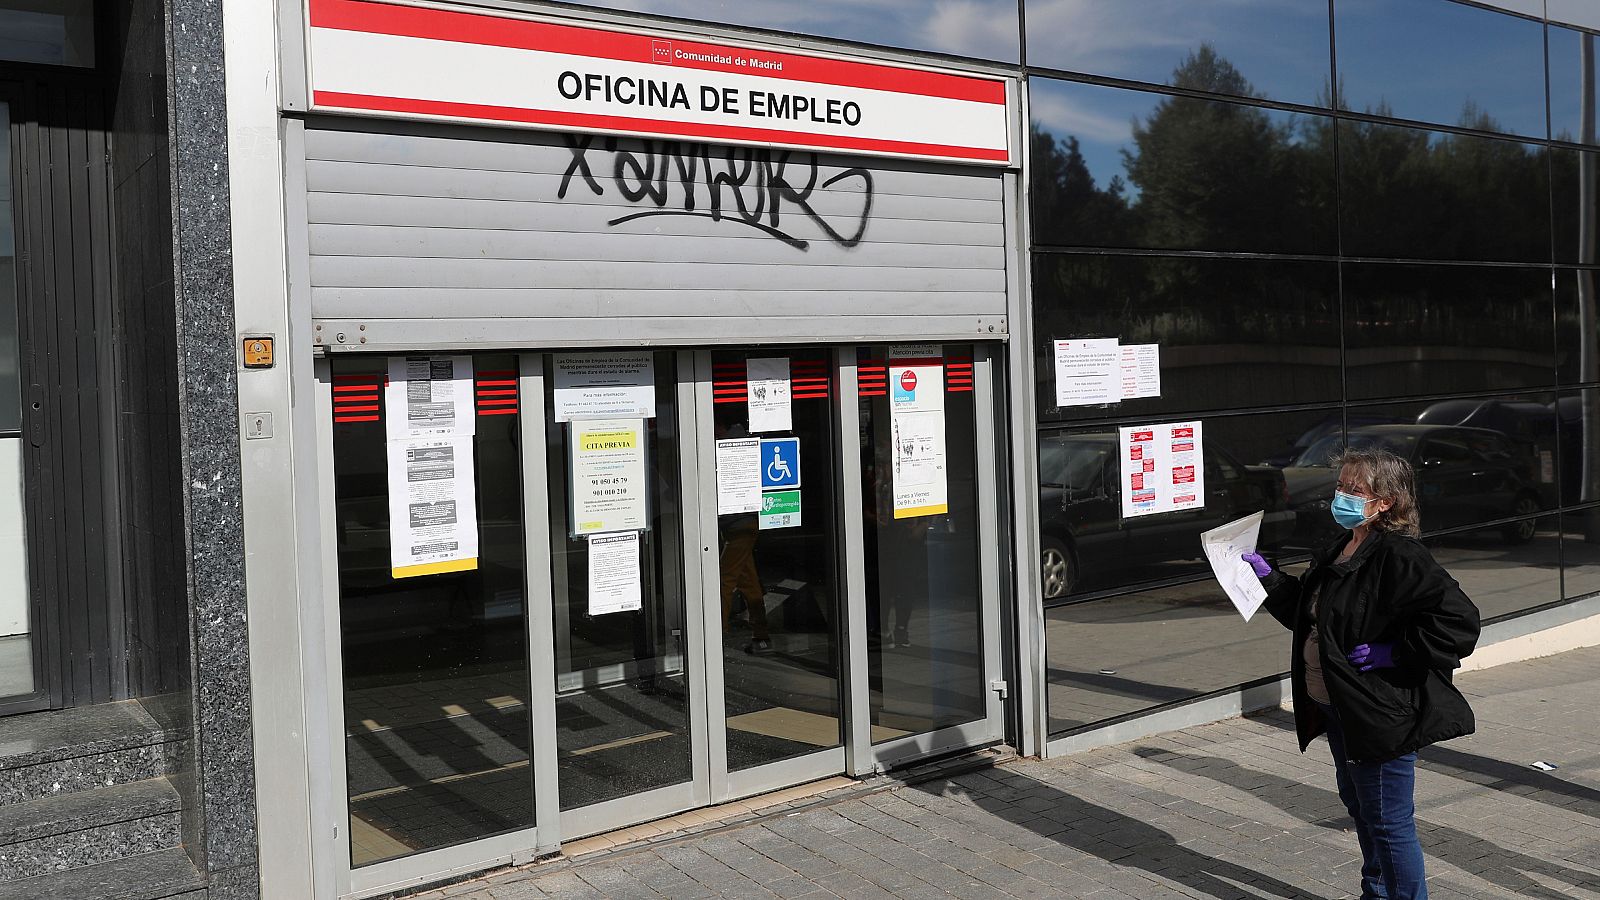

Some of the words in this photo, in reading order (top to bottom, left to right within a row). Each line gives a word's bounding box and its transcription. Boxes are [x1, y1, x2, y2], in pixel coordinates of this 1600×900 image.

[675, 49, 732, 65] Comunidad
[735, 56, 747, 66] de
[750, 58, 783, 71] Madrid
[557, 70, 691, 110] OFICINA
[700, 85, 740, 115] DE
[749, 90, 862, 127] EMPLEO
[604, 441, 630, 449] PREVIA
[616, 487, 627, 495] 210
